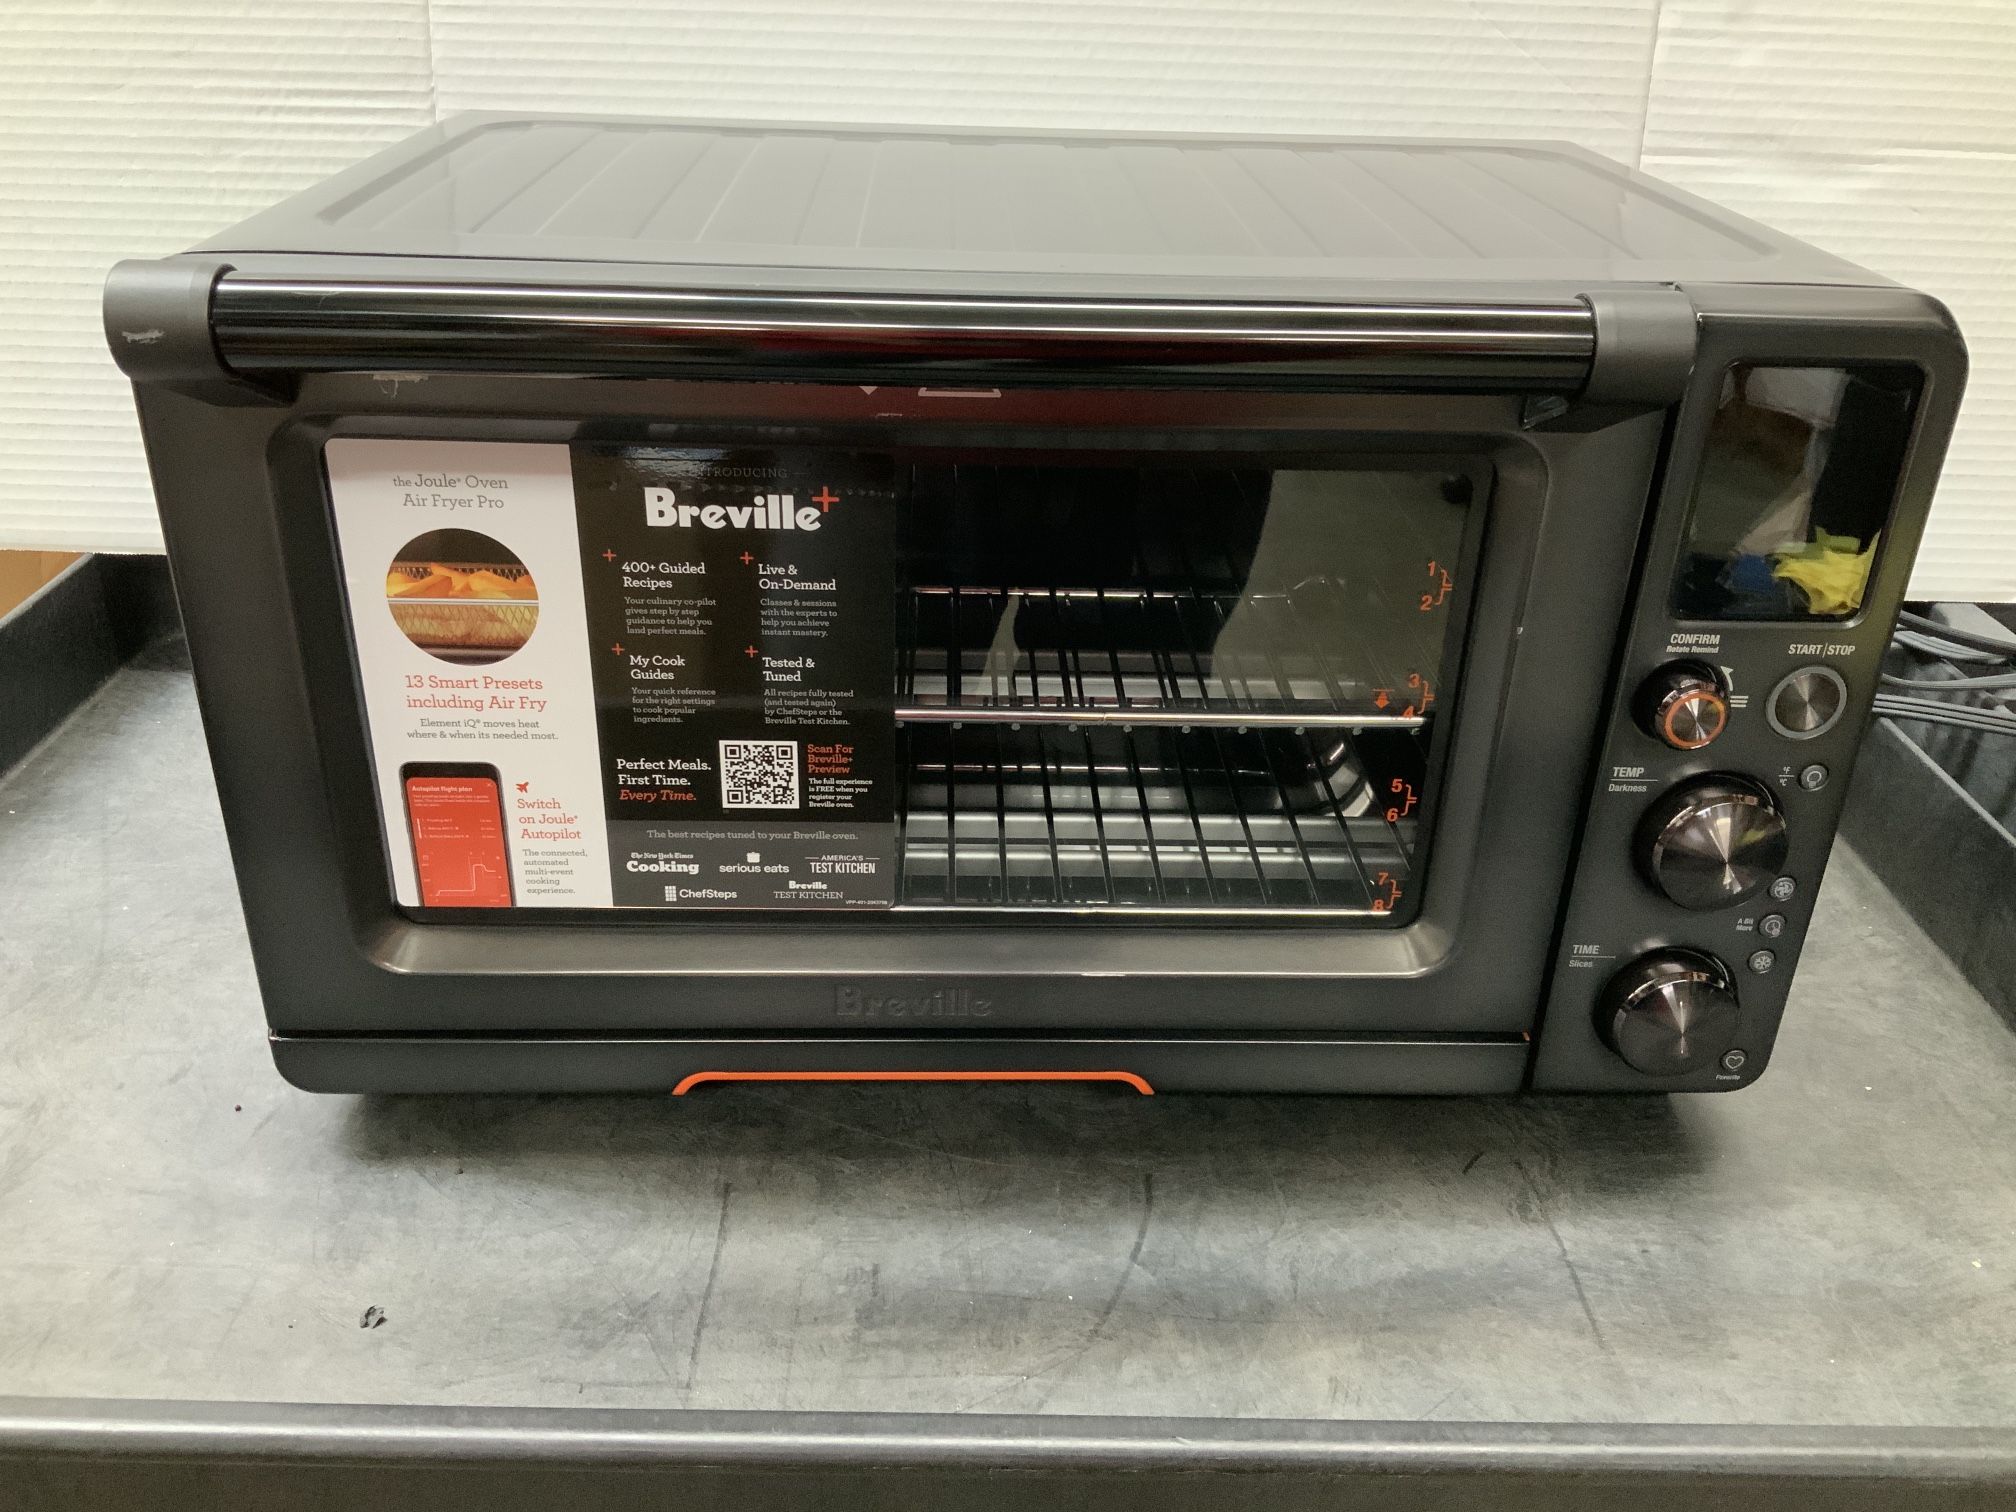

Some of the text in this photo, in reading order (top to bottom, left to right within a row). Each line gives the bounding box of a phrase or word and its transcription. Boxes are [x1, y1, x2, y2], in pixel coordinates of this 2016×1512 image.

[393, 476, 411, 487] the
[465, 475, 508, 489] Oven
[403, 494, 504, 510] Air Fryer Pro
[622, 562, 706, 574] 400+ Guided
[758, 564, 798, 575] Live &
[1428, 561, 1436, 576] 1
[623, 577, 673, 589] Recipes
[759, 579, 836, 591] On-Demand
[625, 597, 716, 608] Your culinary co-pilot
[760, 598, 792, 607] Classes
[794, 599, 800, 607] &
[1421, 595, 1432, 611] 2
[625, 607, 699, 617] gives step by step
[761, 609, 779, 617] with
[781, 609, 794, 617] the
[796, 610, 827, 618] experts
[626, 617, 665, 626] guidance
[677, 617, 695, 627] help
[697, 619, 712, 627] you
[761, 618, 829, 628] help you achieve
[627, 627, 646, 635] land
[647, 627, 677, 636] perfect
[761, 628, 828, 638] instant mastery.
[1670, 633, 1720, 645] CONFIRM
[1691, 646, 1719, 654] Remind
[630, 656, 685, 667] My Cook
[763, 657, 815, 668] Tested &
[631, 669, 674, 680] Guides
[763, 671, 801, 682] Tuned
[406, 675, 543, 689] 13 Smart Presets
[1409, 674, 1420, 688] 3
[632, 687, 716, 697] Your quick reference
[764, 689, 854, 699] All recipes fully tested
[407, 696, 547, 712] including Air Fry
[632, 697, 715, 707] for the right settings
[764, 698, 836, 708] (and tested again)
[643, 706, 663, 714] cook
[664, 707, 696, 716] popular
[765, 708, 775, 716] by
[777, 708, 816, 717] ChefSteps
[829, 708, 842, 716] the
[421, 719, 461, 727] Element
[518, 719, 539, 728] heat
[634, 715, 683, 725] ingredients.
[765, 717, 850, 725] Breville Test Kitchen.
[407, 730, 558, 740] where & when its needed most.
[808, 744, 854, 754] Scan For
[616, 758, 711, 770] Perfect Meals.
[808, 764, 850, 774] Preview
[1613, 767, 1644, 778] TEMP
[618, 774, 691, 786] First Time.
[836, 778, 873, 786] experience
[1391, 779, 1402, 793] 5
[1608, 784, 1647, 792] Darkness
[620, 790, 697, 802] Every Time.
[809, 794, 852, 802] register your
[517, 799, 561, 809] Switch
[519, 816, 535, 824] on
[1387, 808, 1399, 822] 6
[521, 829, 581, 840] Autopilot
[647, 830, 858, 841] The best recipes tuned to your Breville oven.
[523, 849, 587, 857] The connected,
[626, 861, 700, 874] Cooking
[720, 864, 789, 873] serious eats
[810, 863, 875, 874] TEST KITCHEN
[526, 877, 560, 886] cooking
[1378, 872, 1389, 885] 7
[789, 880, 827, 890] Breville
[527, 887, 575, 895] experience.
[680, 889, 737, 900] ChefSteps
[798, 891, 844, 899] KITCHEN
[1573, 945, 1600, 955] TIME
[1569, 960, 1593, 968] Slices
[836, 985, 993, 1017] Breville
